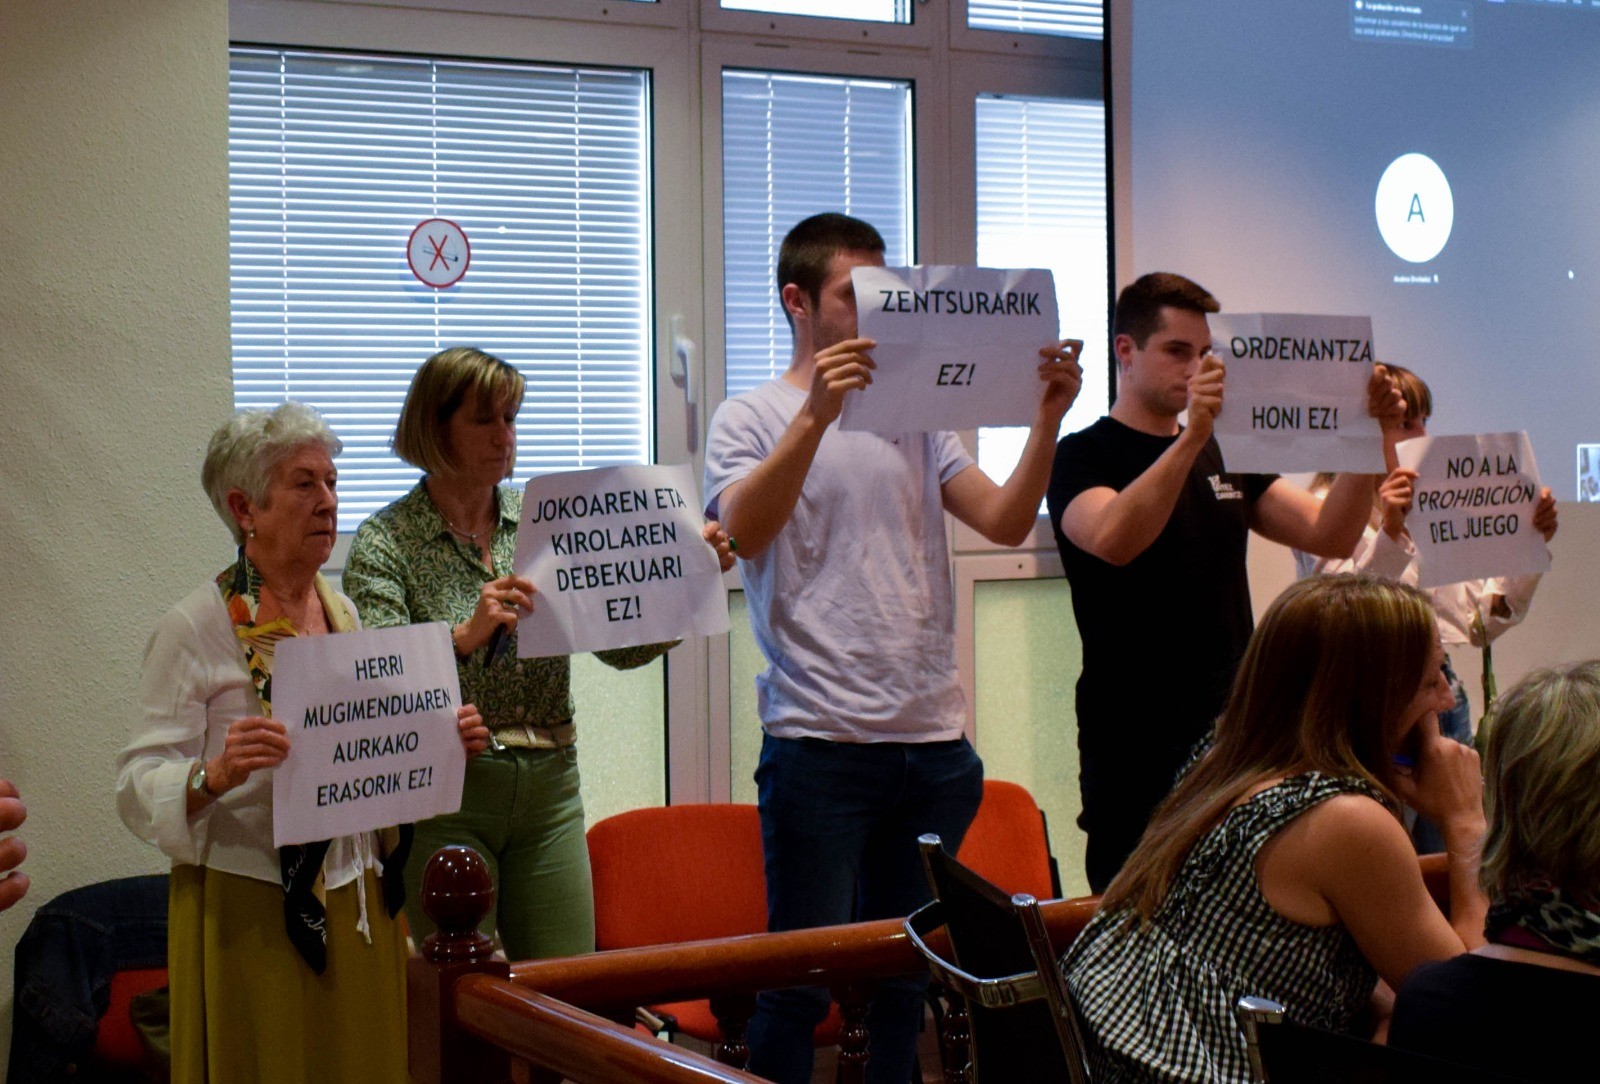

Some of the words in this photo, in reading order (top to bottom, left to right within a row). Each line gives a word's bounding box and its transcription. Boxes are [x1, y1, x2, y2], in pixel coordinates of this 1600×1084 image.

[1407, 193, 1425, 223] A
[879, 290, 1041, 316] ZENTSURARIK
[1231, 336, 1373, 363] ORDENANTZA
[936, 363, 976, 386] EZ!
[1252, 406, 1300, 430] HONI
[1308, 407, 1338, 430] EZ!
[1447, 456, 1474, 479] NO
[1478, 456, 1491, 476] A
[1496, 454, 1517, 475] LA
[532, 489, 648, 524] JOKOAREN
[654, 488, 687, 509] ETA
[1418, 480, 1535, 512] PROHIBICIÓN
[551, 522, 677, 556] KIROLAREN
[1430, 520, 1459, 543] DEL
[1463, 514, 1519, 539] JUEGO
[556, 555, 683, 592] DEBEKUARI
[606, 595, 642, 622] EZ!
[355, 655, 404, 681] HERRI
[303, 688, 452, 729] MUGIMENDUAREN
[332, 731, 419, 764] AURKAKO
[317, 771, 401, 807] ERASORIK
[408, 766, 433, 790] EZ!
